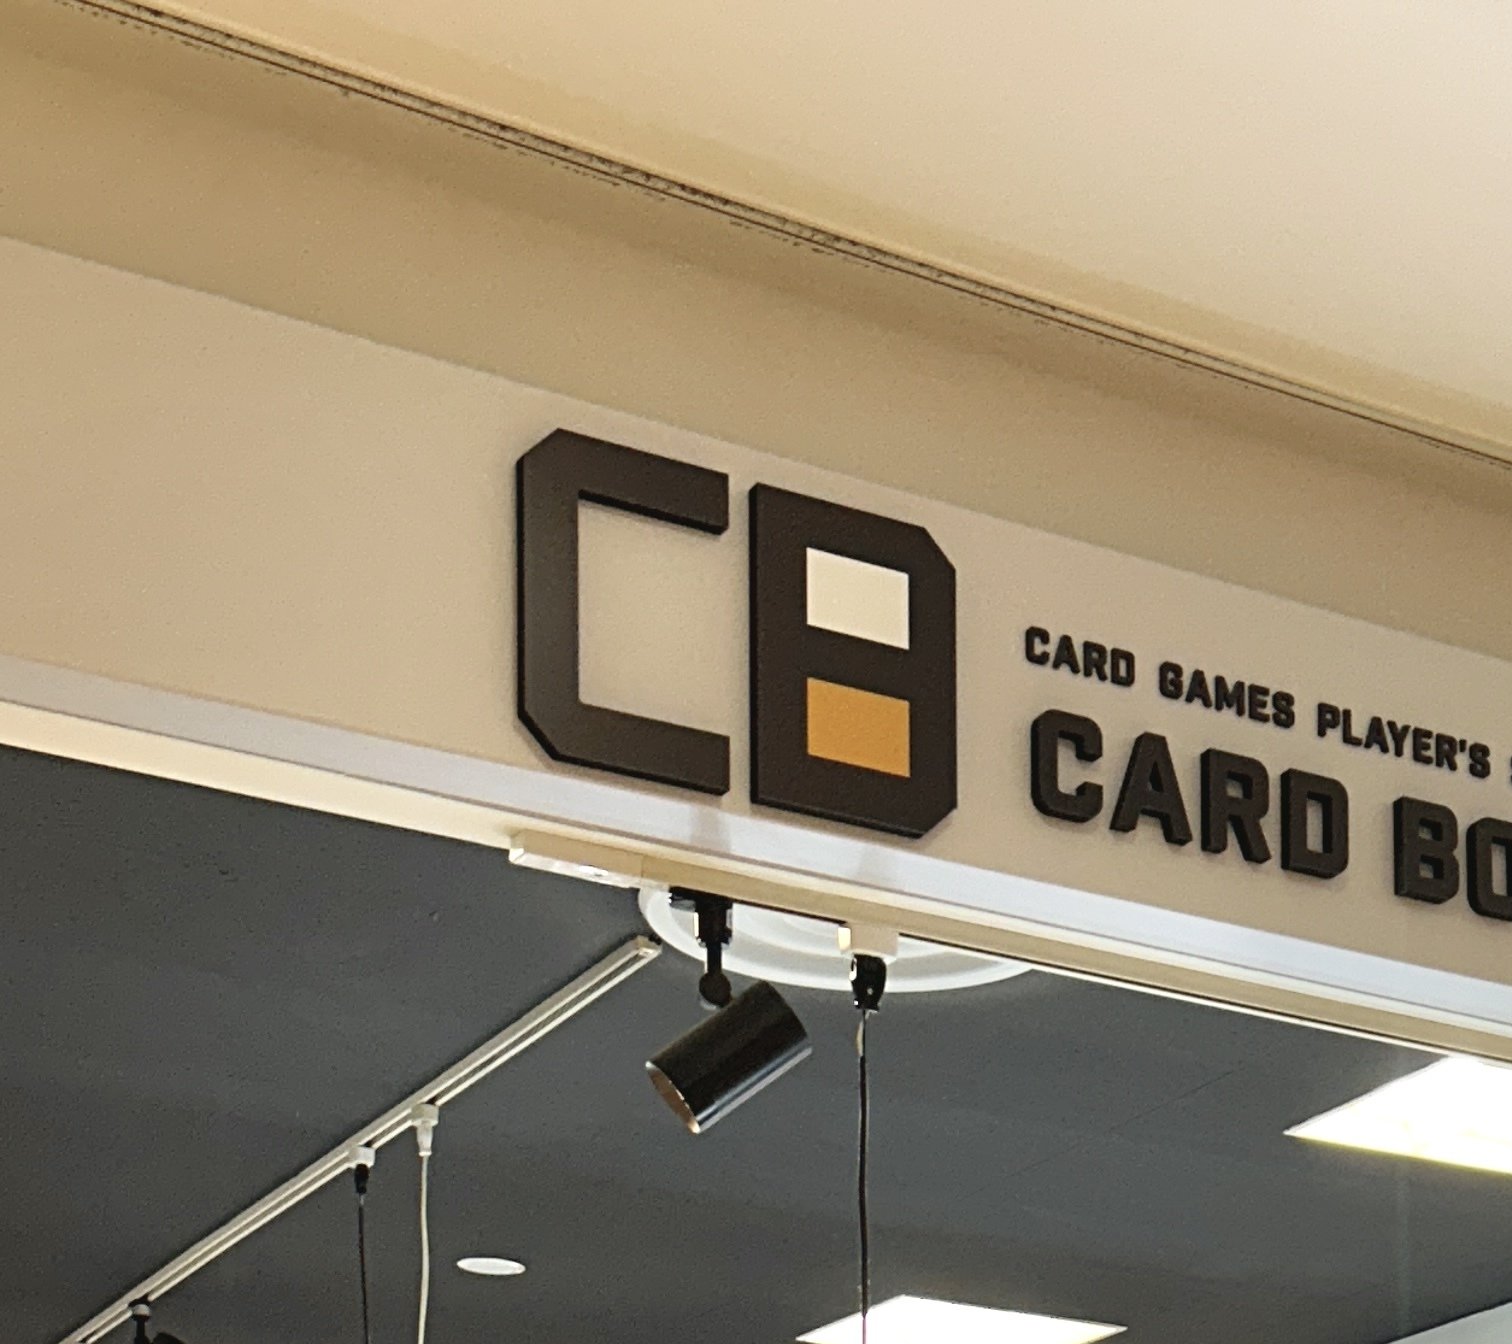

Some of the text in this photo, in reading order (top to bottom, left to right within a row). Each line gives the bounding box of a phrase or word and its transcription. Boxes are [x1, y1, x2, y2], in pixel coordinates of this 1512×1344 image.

[1025, 625, 1136, 688] CARD
[1158, 660, 1296, 729] GAMES
[1316, 701, 1492, 780] PLAYER'S
[1030, 708, 1350, 880] CARD
